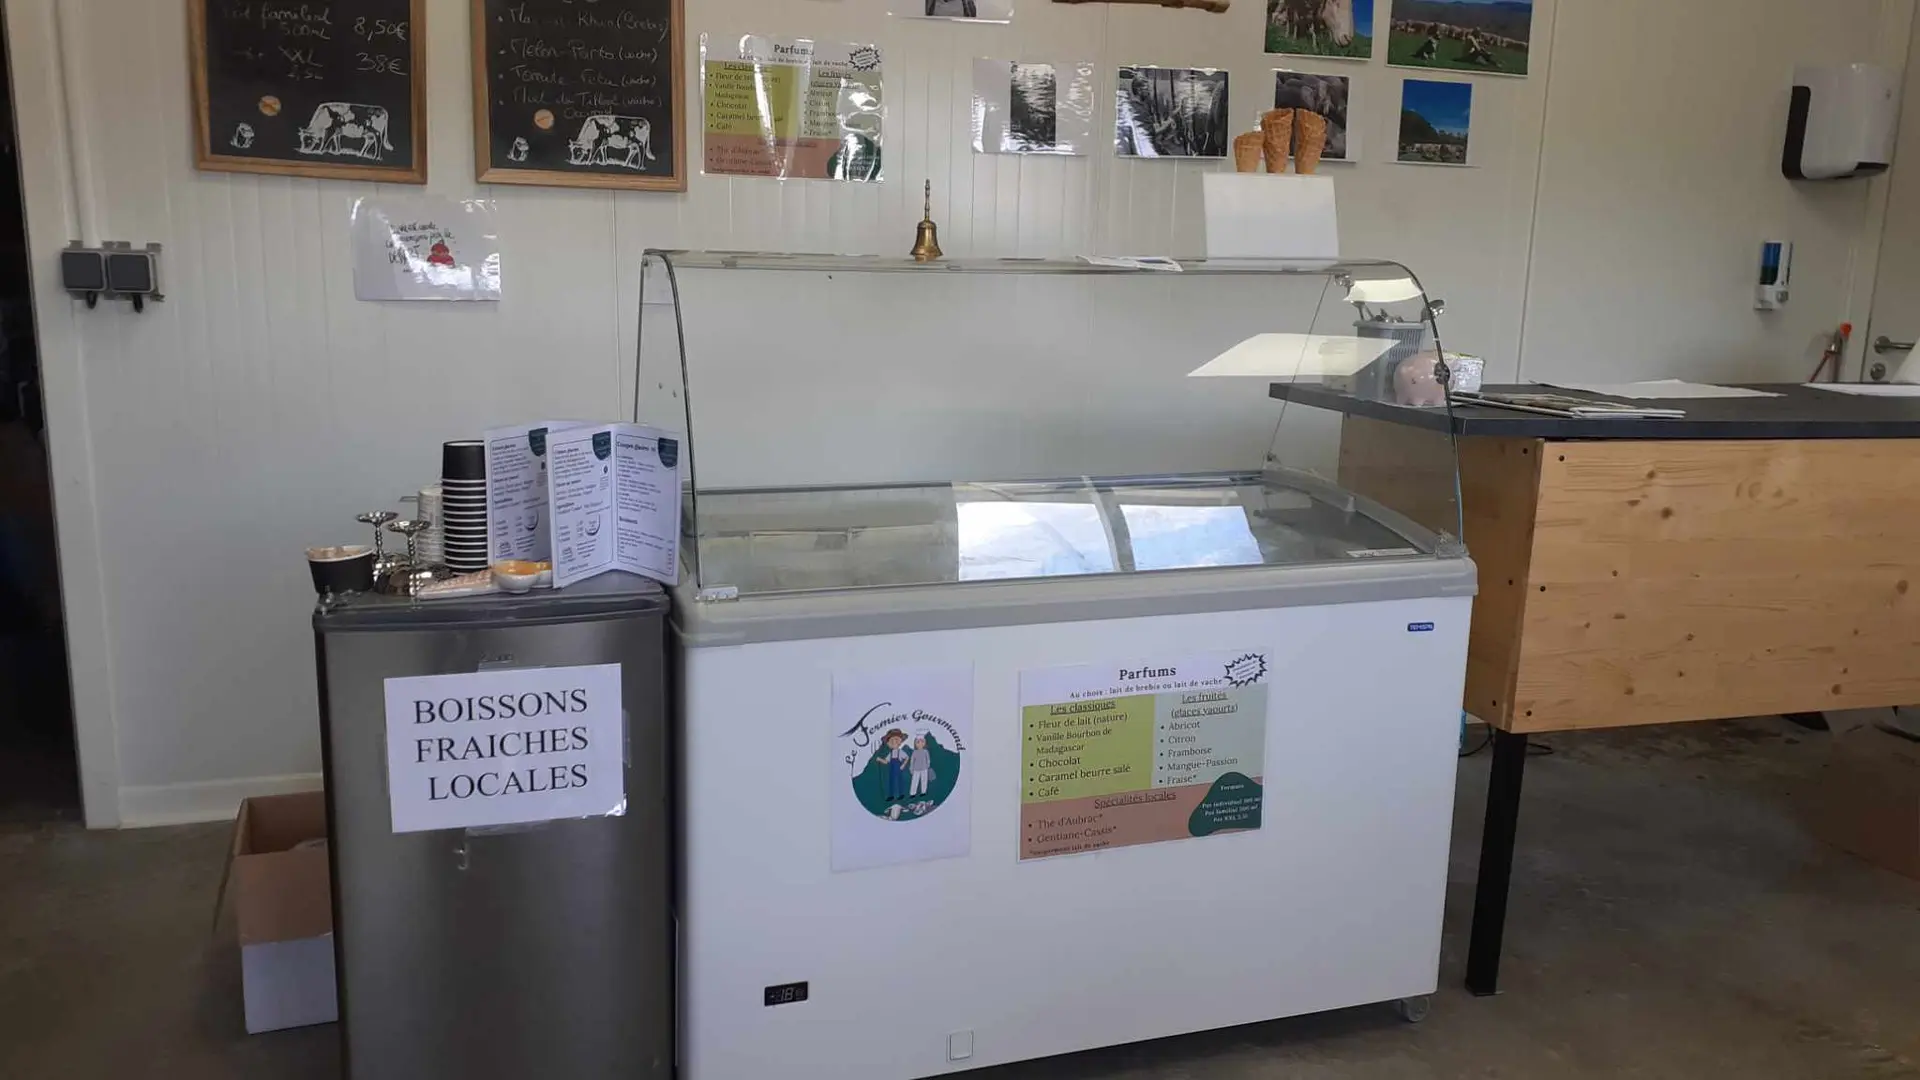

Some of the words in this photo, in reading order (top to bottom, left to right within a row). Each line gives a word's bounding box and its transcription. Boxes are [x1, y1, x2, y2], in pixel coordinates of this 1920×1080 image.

[353, 16, 408, 42] 8,50€
[355, 51, 407, 75] 38€
[1119, 666, 1177, 681] Parfums
[1109, 686, 1123, 694] lait
[1135, 683, 1160, 691] brebis
[1174, 681, 1187, 689] lait
[1200, 678, 1222, 686] vache
[1182, 691, 1198, 704] Les
[1199, 691, 1228, 703] fruités
[413, 688, 588, 724] BOISSONS
[1050, 704, 1067, 716] Les
[1069, 700, 1116, 714] classiques
[1171, 707, 1200, 719] (glaces
[838, 701, 908, 747] Fermier
[911, 709, 966, 752] Gourmand
[1038, 719, 1061, 729] Fleur
[1063, 718, 1076, 727] de
[1077, 716, 1091, 726] lait
[1093, 712, 1128, 725] (nature)
[1168, 721, 1200, 731] Abricot
[1036, 732, 1065, 742] Vanille
[1066, 729, 1101, 740] Bourbon
[1102, 727, 1112, 736] de
[1168, 735, 1196, 744] Citron
[414, 726, 589, 763] FRAICHES
[1036, 744, 1084, 756] Madagascar
[1167, 747, 1212, 758] Framboise
[1038, 756, 1081, 768] Chocolat
[1167, 758, 1238, 772] Mangue-Passion
[1038, 770, 1078, 783] Caramel
[1080, 767, 1111, 779] beurre
[1113, 765, 1131, 774] salé
[428, 763, 589, 801] LOCALES
[1037, 786, 1060, 798] Café
[1145, 791, 1177, 803] locales
